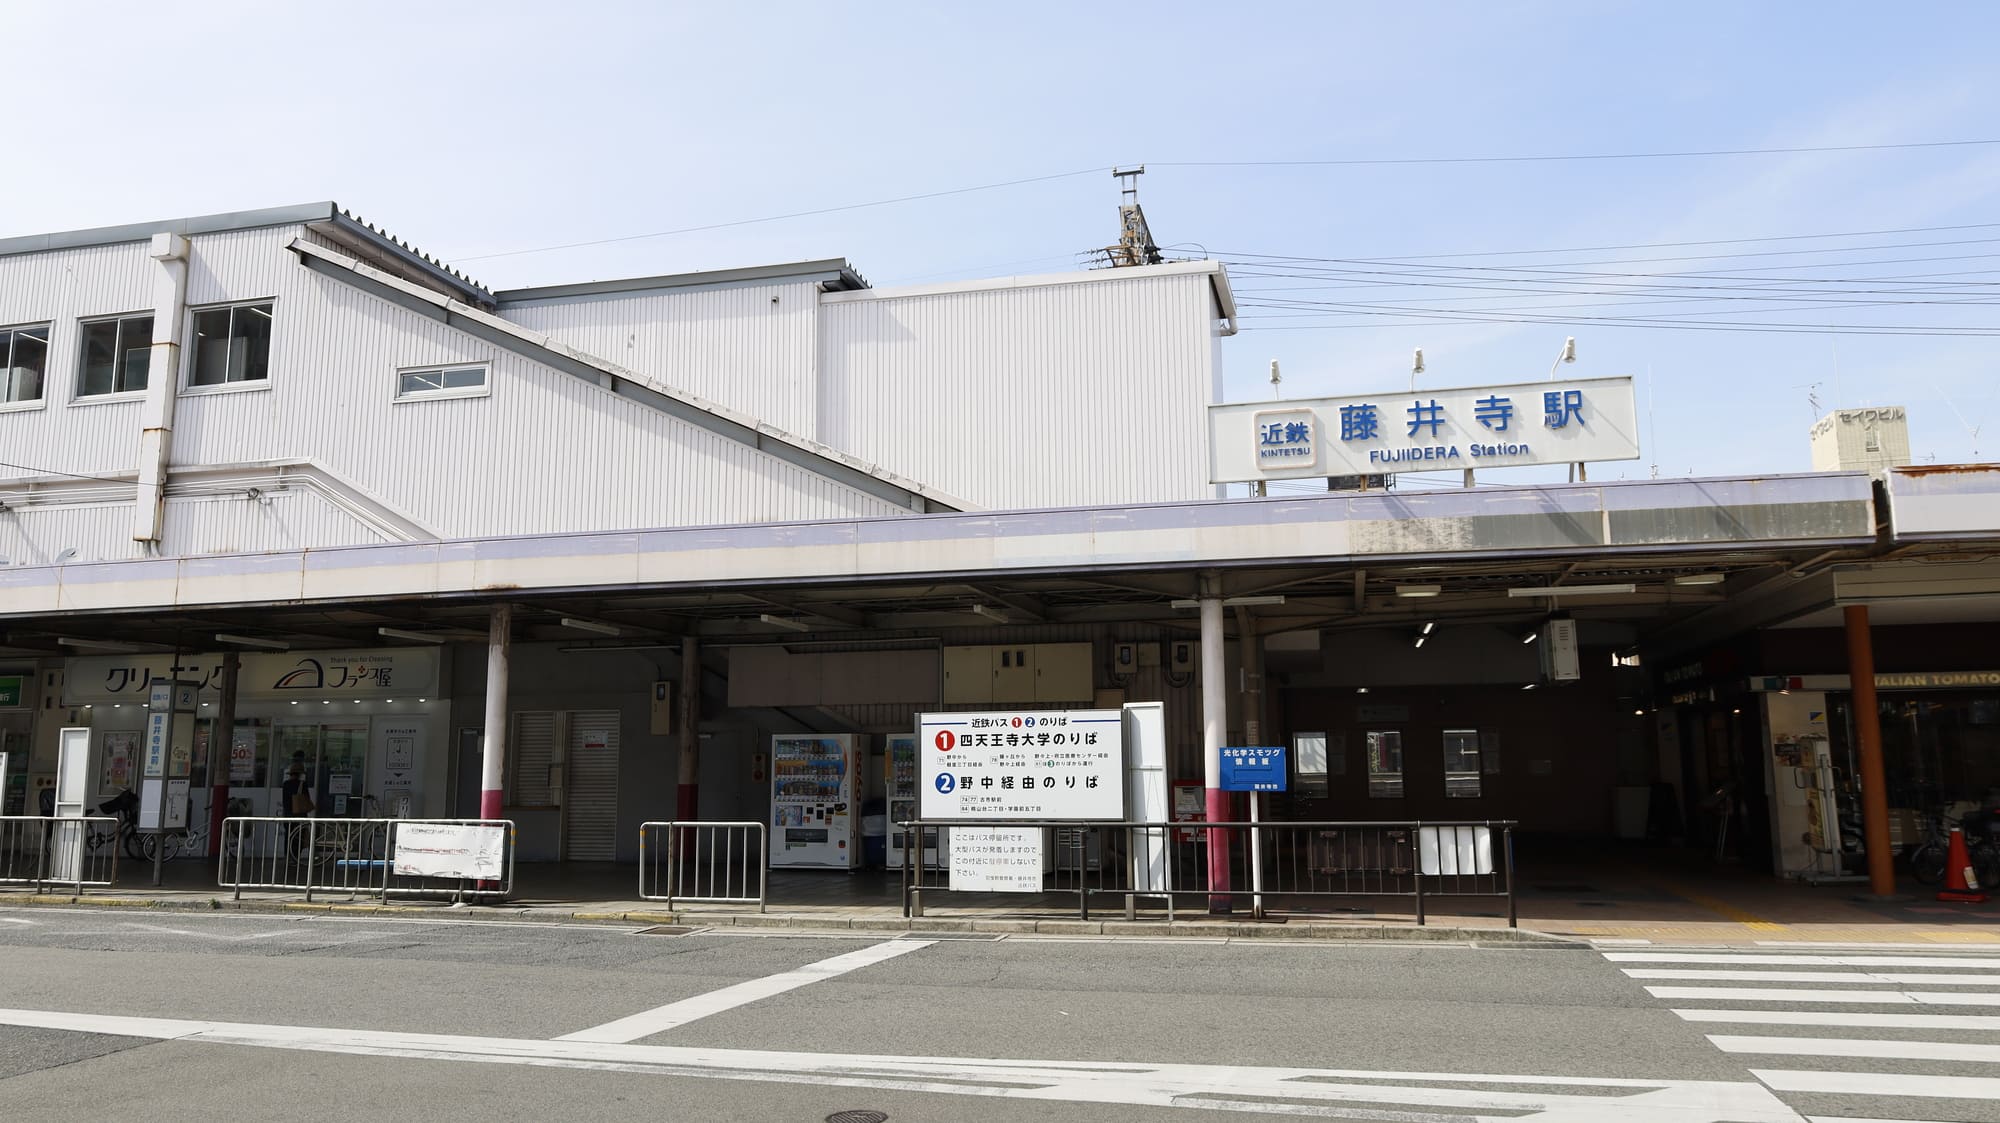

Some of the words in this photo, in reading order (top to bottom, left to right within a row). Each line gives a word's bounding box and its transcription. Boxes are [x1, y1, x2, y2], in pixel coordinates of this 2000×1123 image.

[1339, 390, 1585, 442] 藤井寺駅
[1840, 408, 1904, 423] セイワビル
[1261, 422, 1310, 445] 近鉄
[1261, 447, 1311, 458] KINTETSU
[1370, 446, 1460, 464] FUJIIDERA
[1470, 442, 1529, 458] Station
[1874, 676, 1927, 687] TALIAN
[1932, 673, 2000, 686] TOMATO
[972, 718, 1008, 728] 近鉄バス
[1040, 717, 1068, 726] のりば
[960, 732, 1099, 747] 四天王寺大学のりば
[960, 776, 1100, 790] 野中経由のりば
